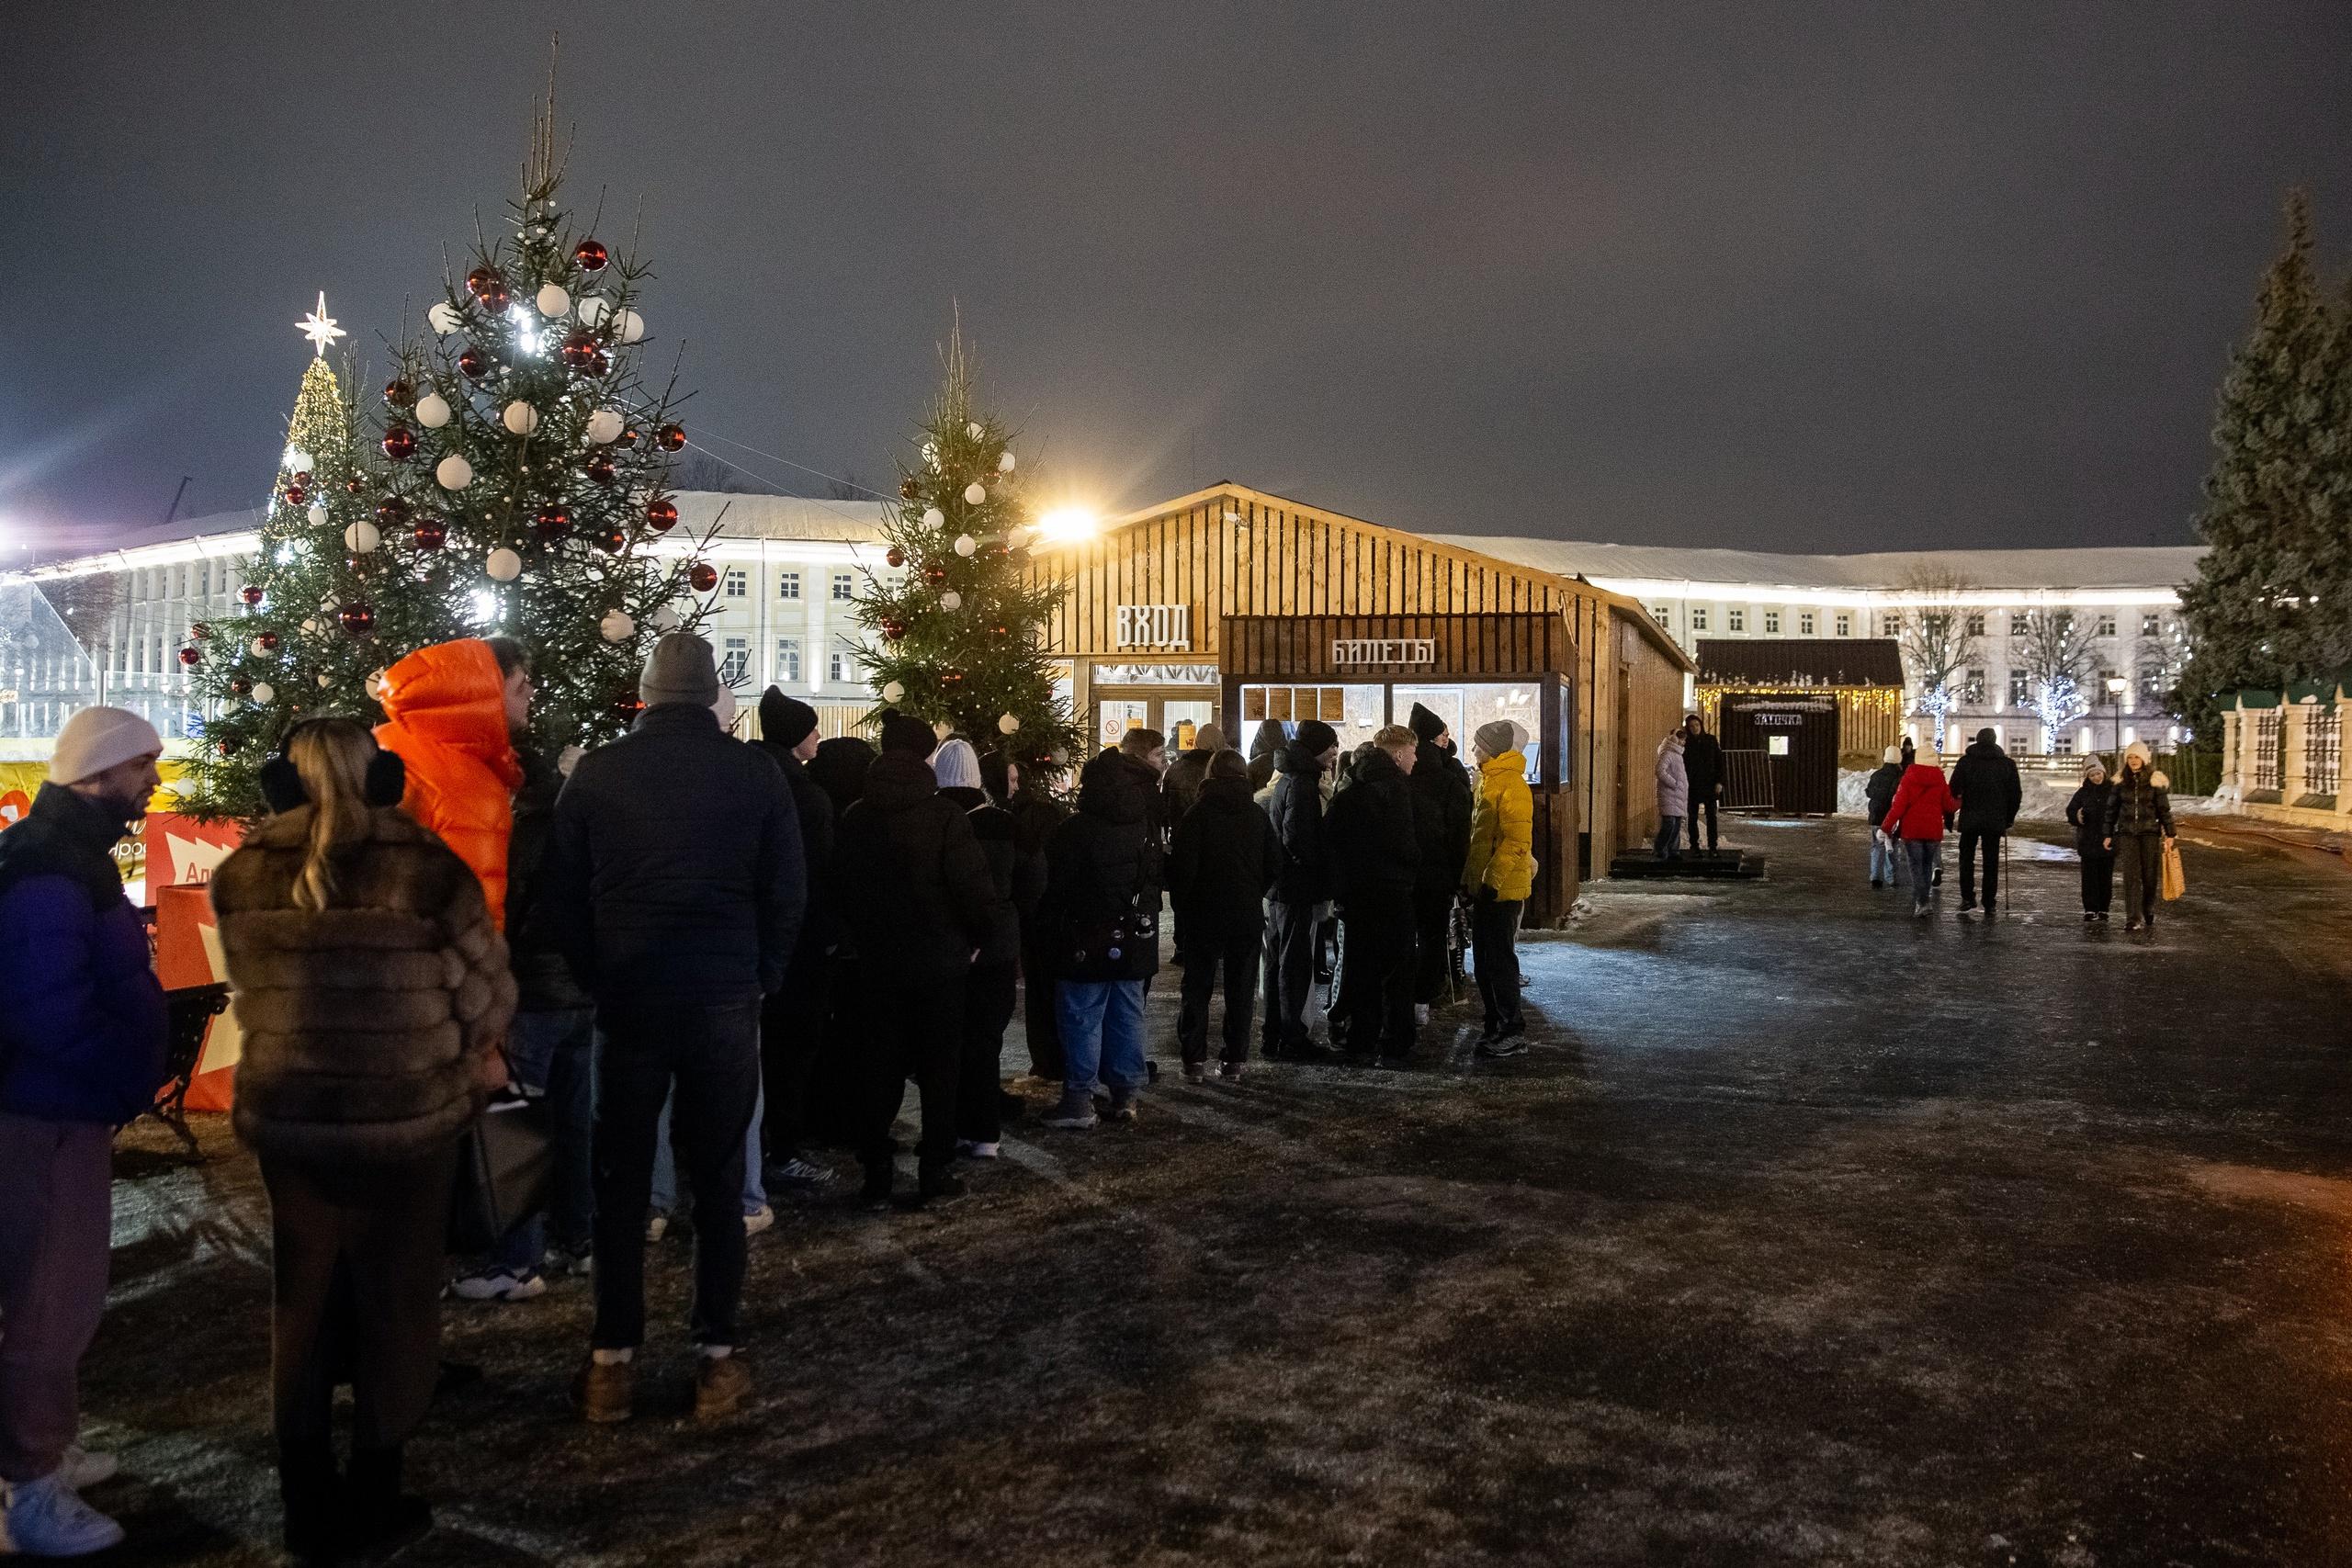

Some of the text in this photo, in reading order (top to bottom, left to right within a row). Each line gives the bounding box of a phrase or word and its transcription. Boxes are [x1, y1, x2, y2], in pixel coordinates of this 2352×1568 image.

[1116, 604, 1191, 652] ВХОД
[1331, 639, 1435, 664] БИЛЕТЫ
[1754, 713, 1803, 726] ЗАТОЧКА
[186, 862, 214, 883] Ал
